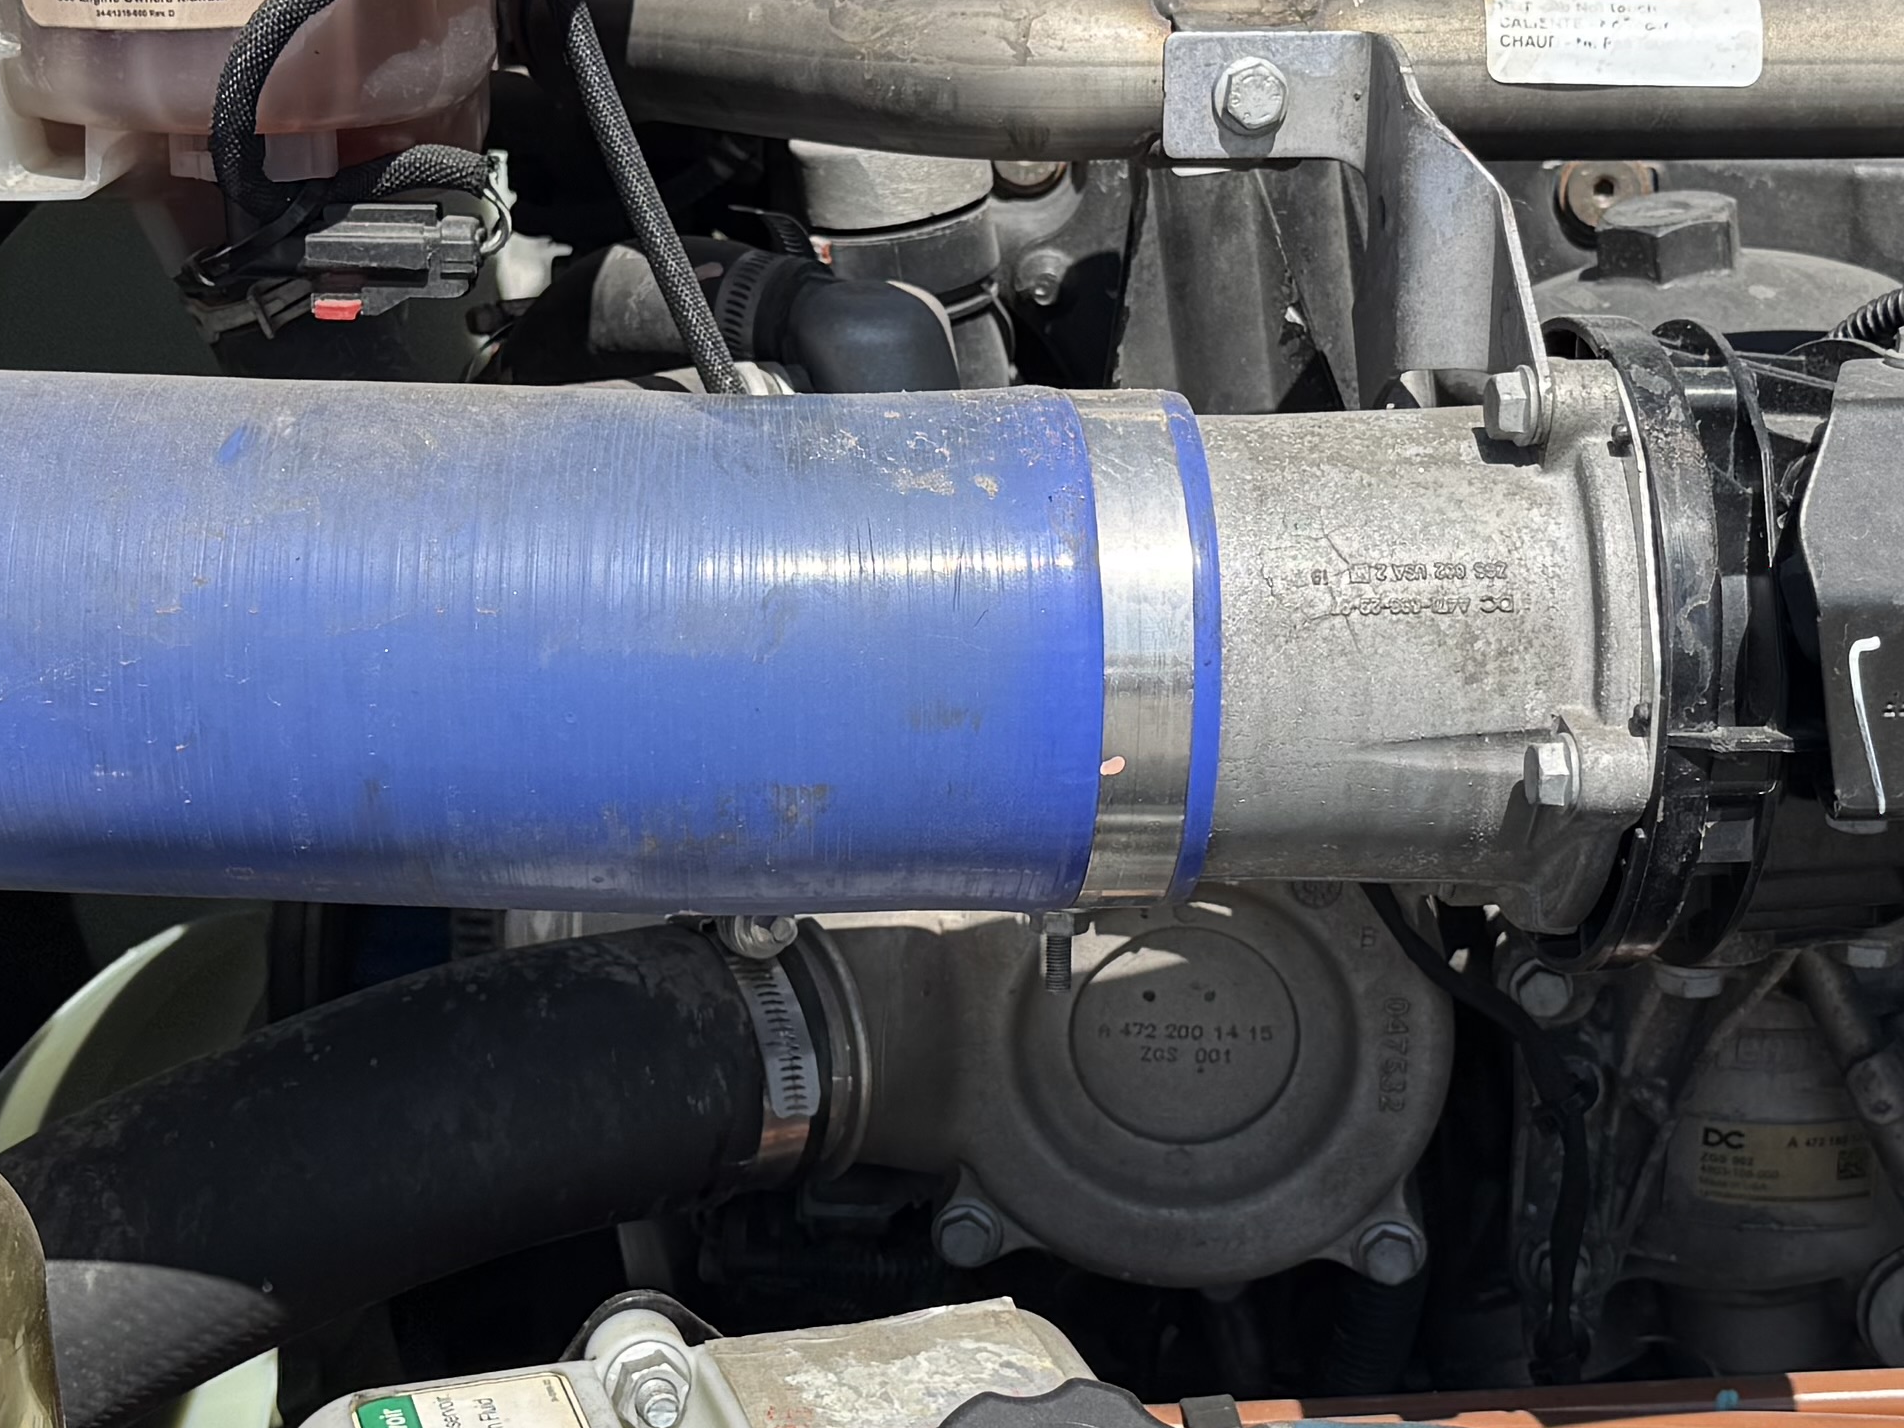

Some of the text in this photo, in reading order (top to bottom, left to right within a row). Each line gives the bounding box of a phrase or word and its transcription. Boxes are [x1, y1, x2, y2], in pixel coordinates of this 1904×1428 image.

[1392, 564, 1427, 581] USA
[1119, 1024, 1157, 1040] 472
[1165, 1024, 1203, 1040] 200
[1215, 1026, 1239, 1040] 14
[1249, 1026, 1273, 1041] 15
[1141, 1048, 1233, 1063] ZGS 001
[1702, 1127, 1746, 1150] DC
[477, 1397, 498, 1421] Fluid
